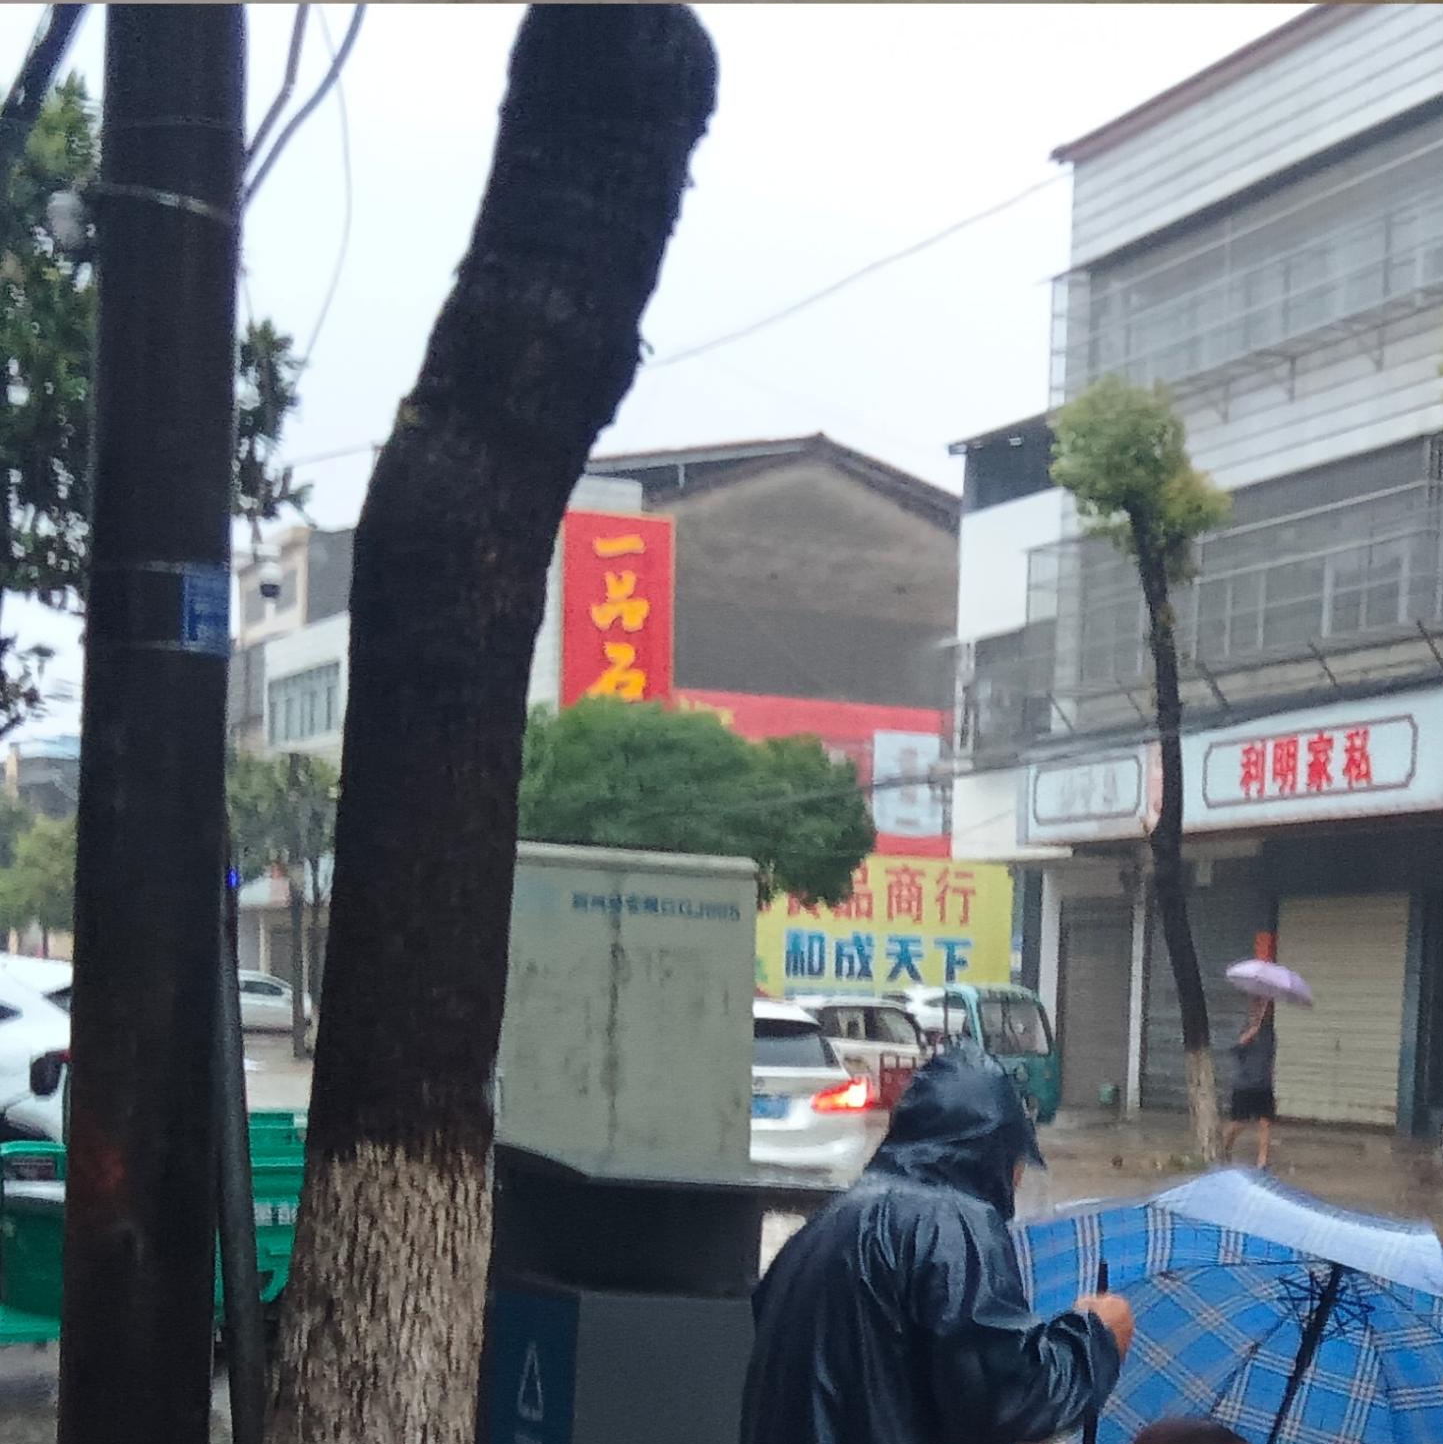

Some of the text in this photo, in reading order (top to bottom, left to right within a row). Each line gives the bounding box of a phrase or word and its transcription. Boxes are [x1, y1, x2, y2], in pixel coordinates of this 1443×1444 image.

[1239, 726, 1373, 799] 利明家私
[787, 864, 977, 926] 品商行
[785, 929, 973, 985] 和成天下
